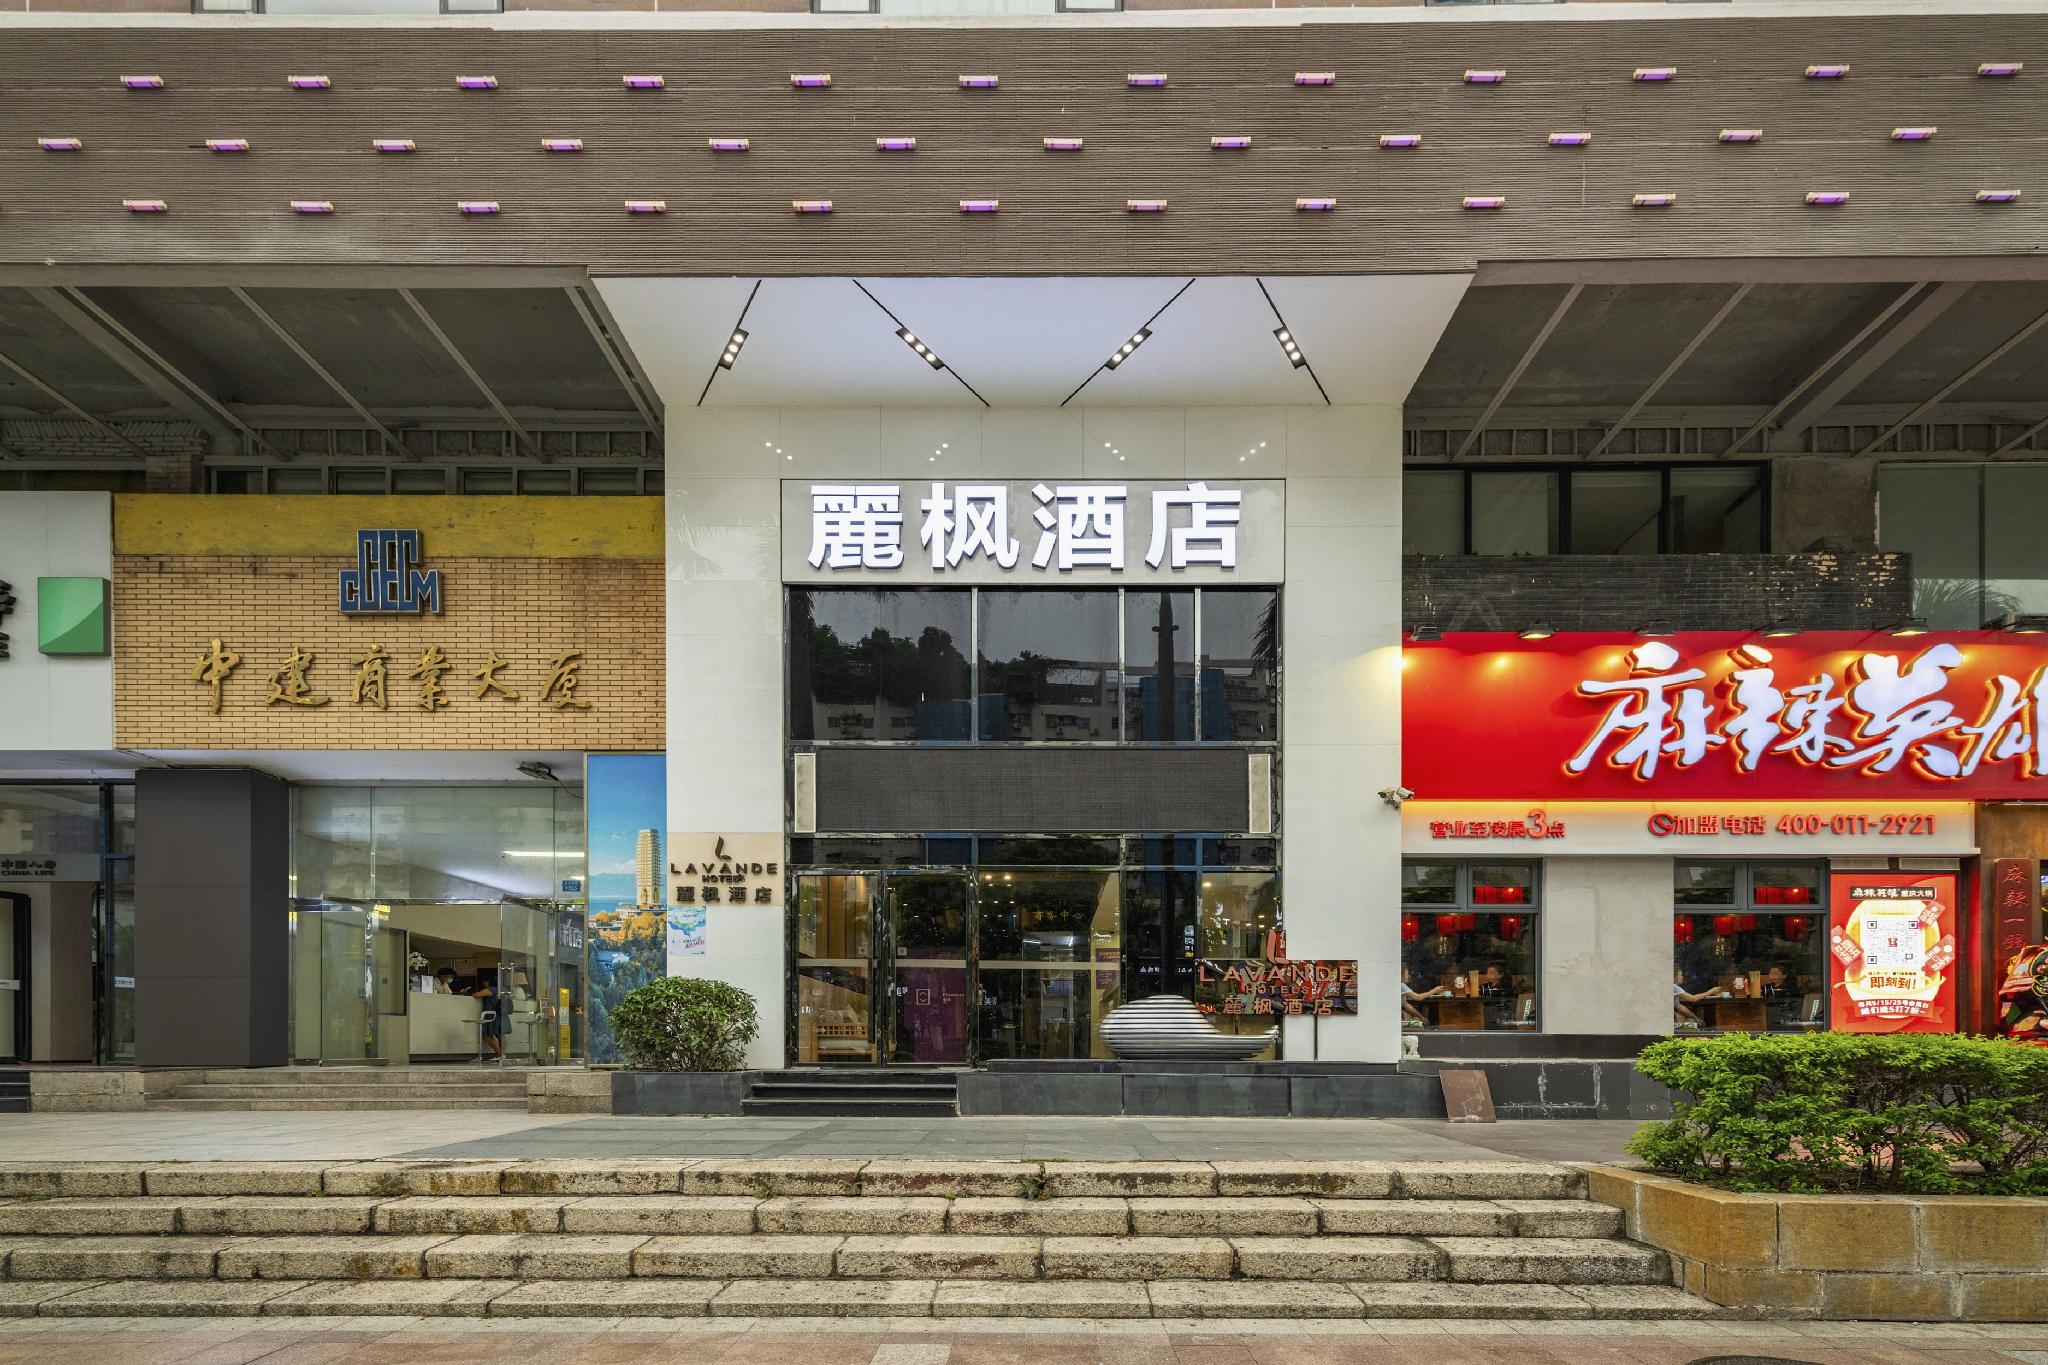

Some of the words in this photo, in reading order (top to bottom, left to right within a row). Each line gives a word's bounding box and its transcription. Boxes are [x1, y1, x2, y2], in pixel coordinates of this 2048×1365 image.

[808, 481, 1241, 571] 麗枫酒店
[1430, 809, 1566, 839] 营业至凌晨3点
[1674, 815, 1767, 835] 加盟电话
[1776, 815, 1937, 835] 400-011-2921
[670, 862, 778, 875] LAVANDE
[1200, 965, 1355, 983] LAVANDE
[1246, 985, 1310, 995] HOTELS
